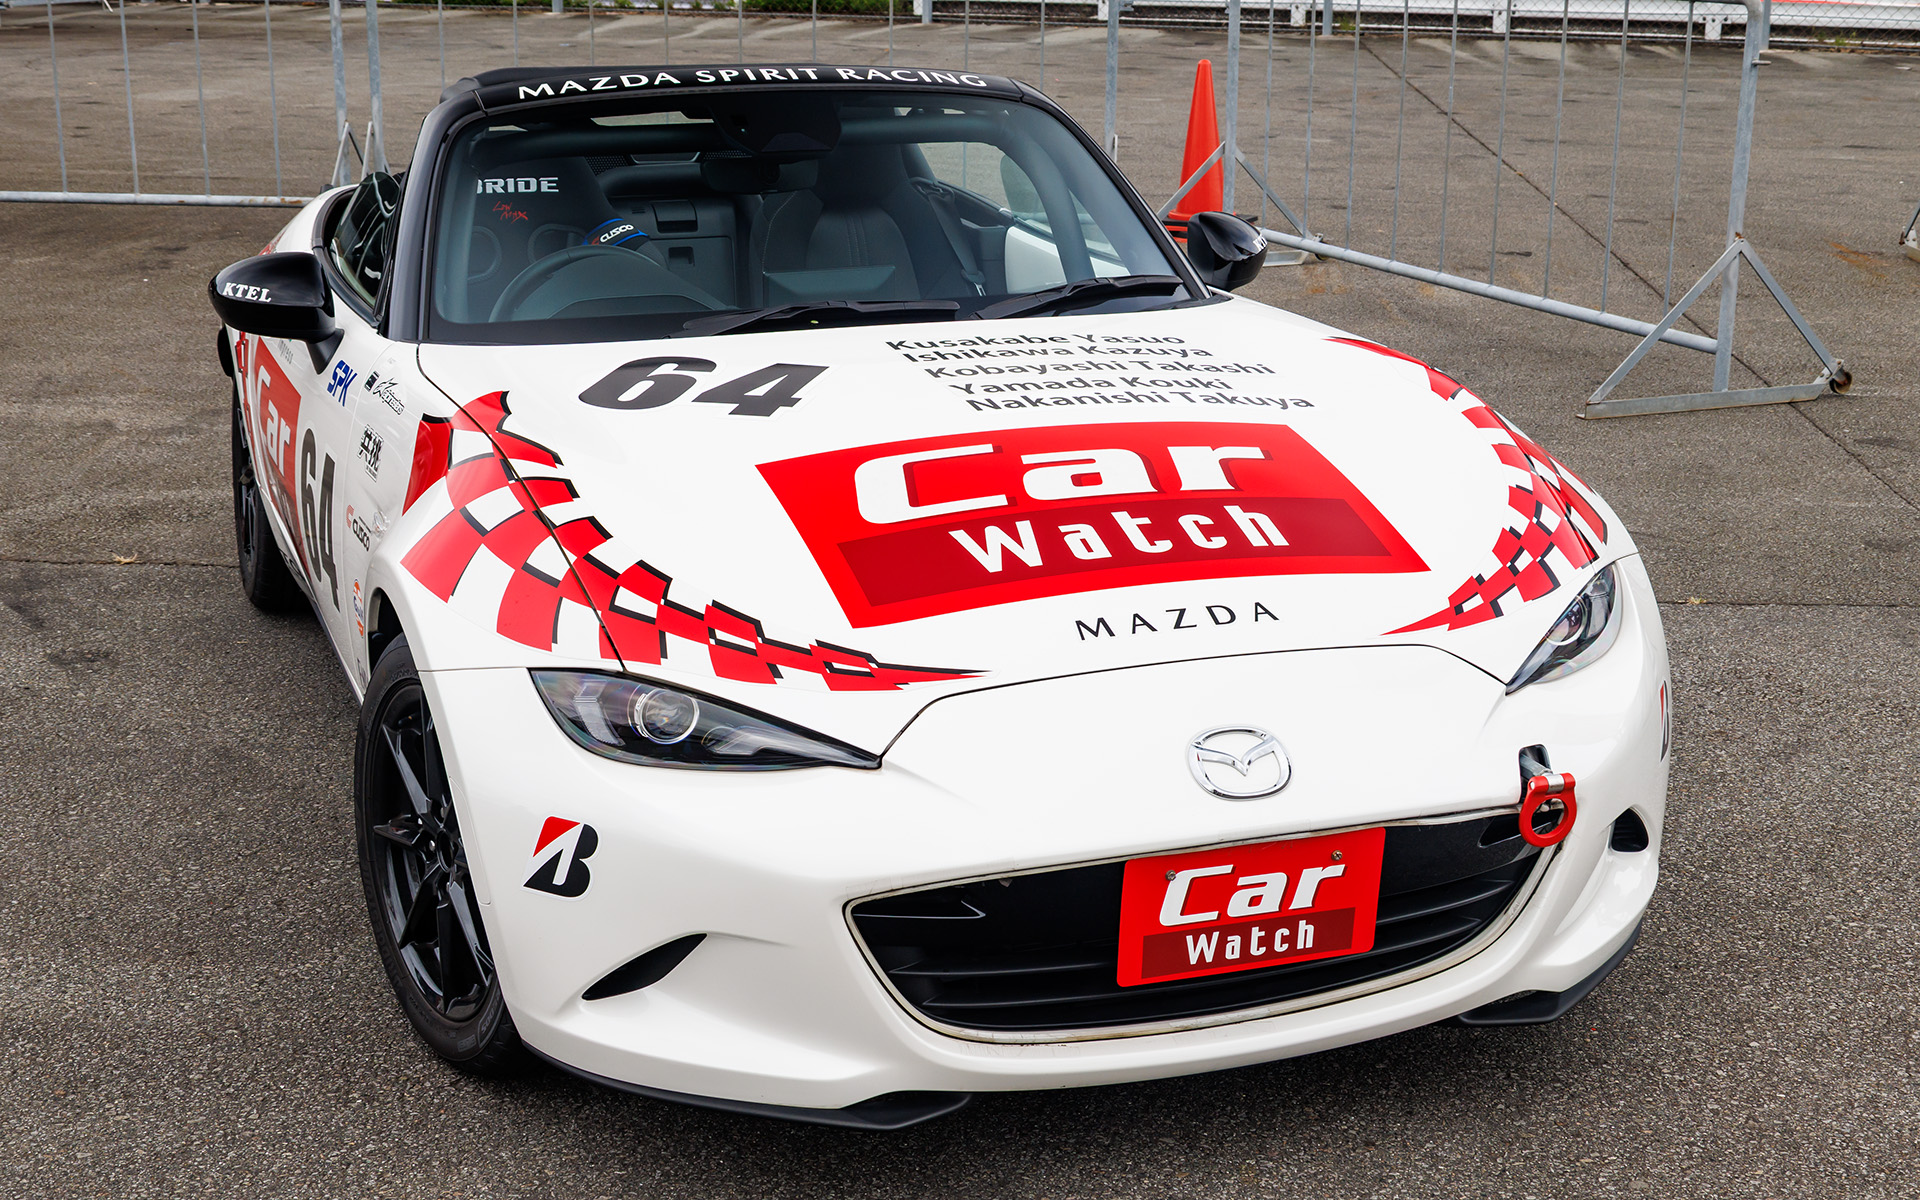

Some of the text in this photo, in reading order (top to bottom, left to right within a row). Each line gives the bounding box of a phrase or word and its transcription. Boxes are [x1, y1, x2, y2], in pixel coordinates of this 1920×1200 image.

[518, 67, 987, 100] MAZDA SPIRIT RACING
[222, 282, 272, 303] KTEL
[885, 333, 1186, 351] Kusakabe Yasuo
[902, 345, 1214, 363] Ishikawa Kazuya
[326, 359, 358, 408] SPK
[578, 355, 830, 418] 64
[923, 360, 1277, 379] Kobayashi Takashi
[947, 376, 1234, 395] Yamada Kouki
[256, 364, 291, 478] Car
[965, 390, 1316, 412] Nakanishi Takuya
[853, 443, 1271, 525] Car
[300, 428, 340, 613] 64
[948, 504, 1290, 573] Watch
[1074, 600, 1280, 641] MAZDA
[1159, 864, 1346, 927] Car
[1186, 920, 1315, 965] Watch
